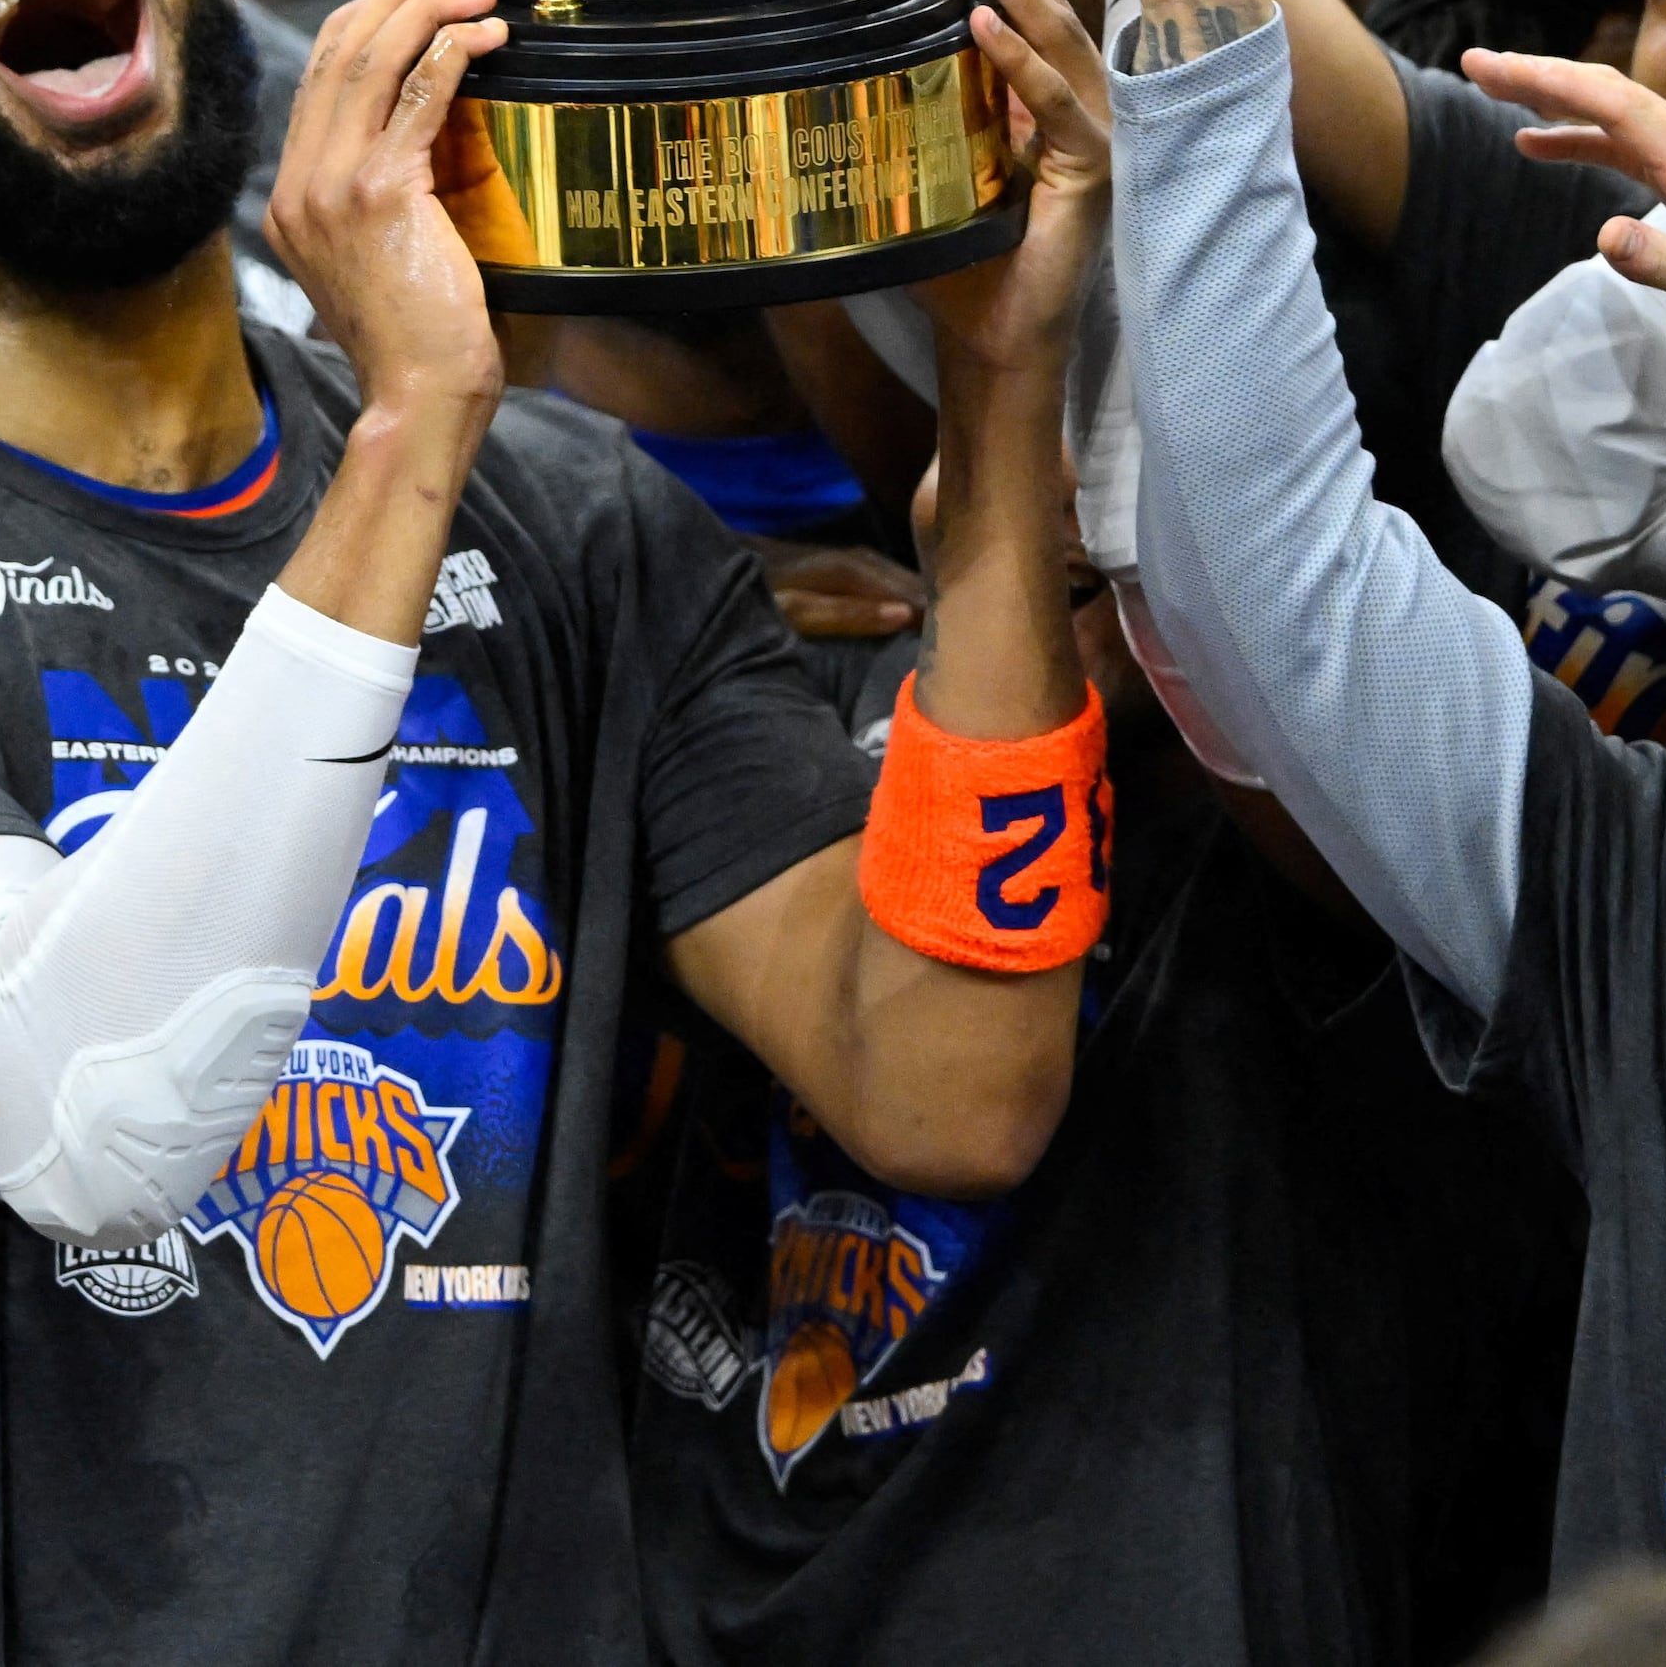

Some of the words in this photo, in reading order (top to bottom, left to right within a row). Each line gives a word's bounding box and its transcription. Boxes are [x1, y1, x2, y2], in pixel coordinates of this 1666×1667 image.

[658, 139, 713, 182] THE
[722, 132, 780, 178] BOB
[565, 190, 621, 228] NBA
[630, 183, 755, 227] EASTERN
[389, 744, 519, 766] HAMPIONS
[316, 1048, 371, 1084] YORK
[214, 1075, 451, 1205] NICKS
[440, 1265, 502, 1302] YORK
